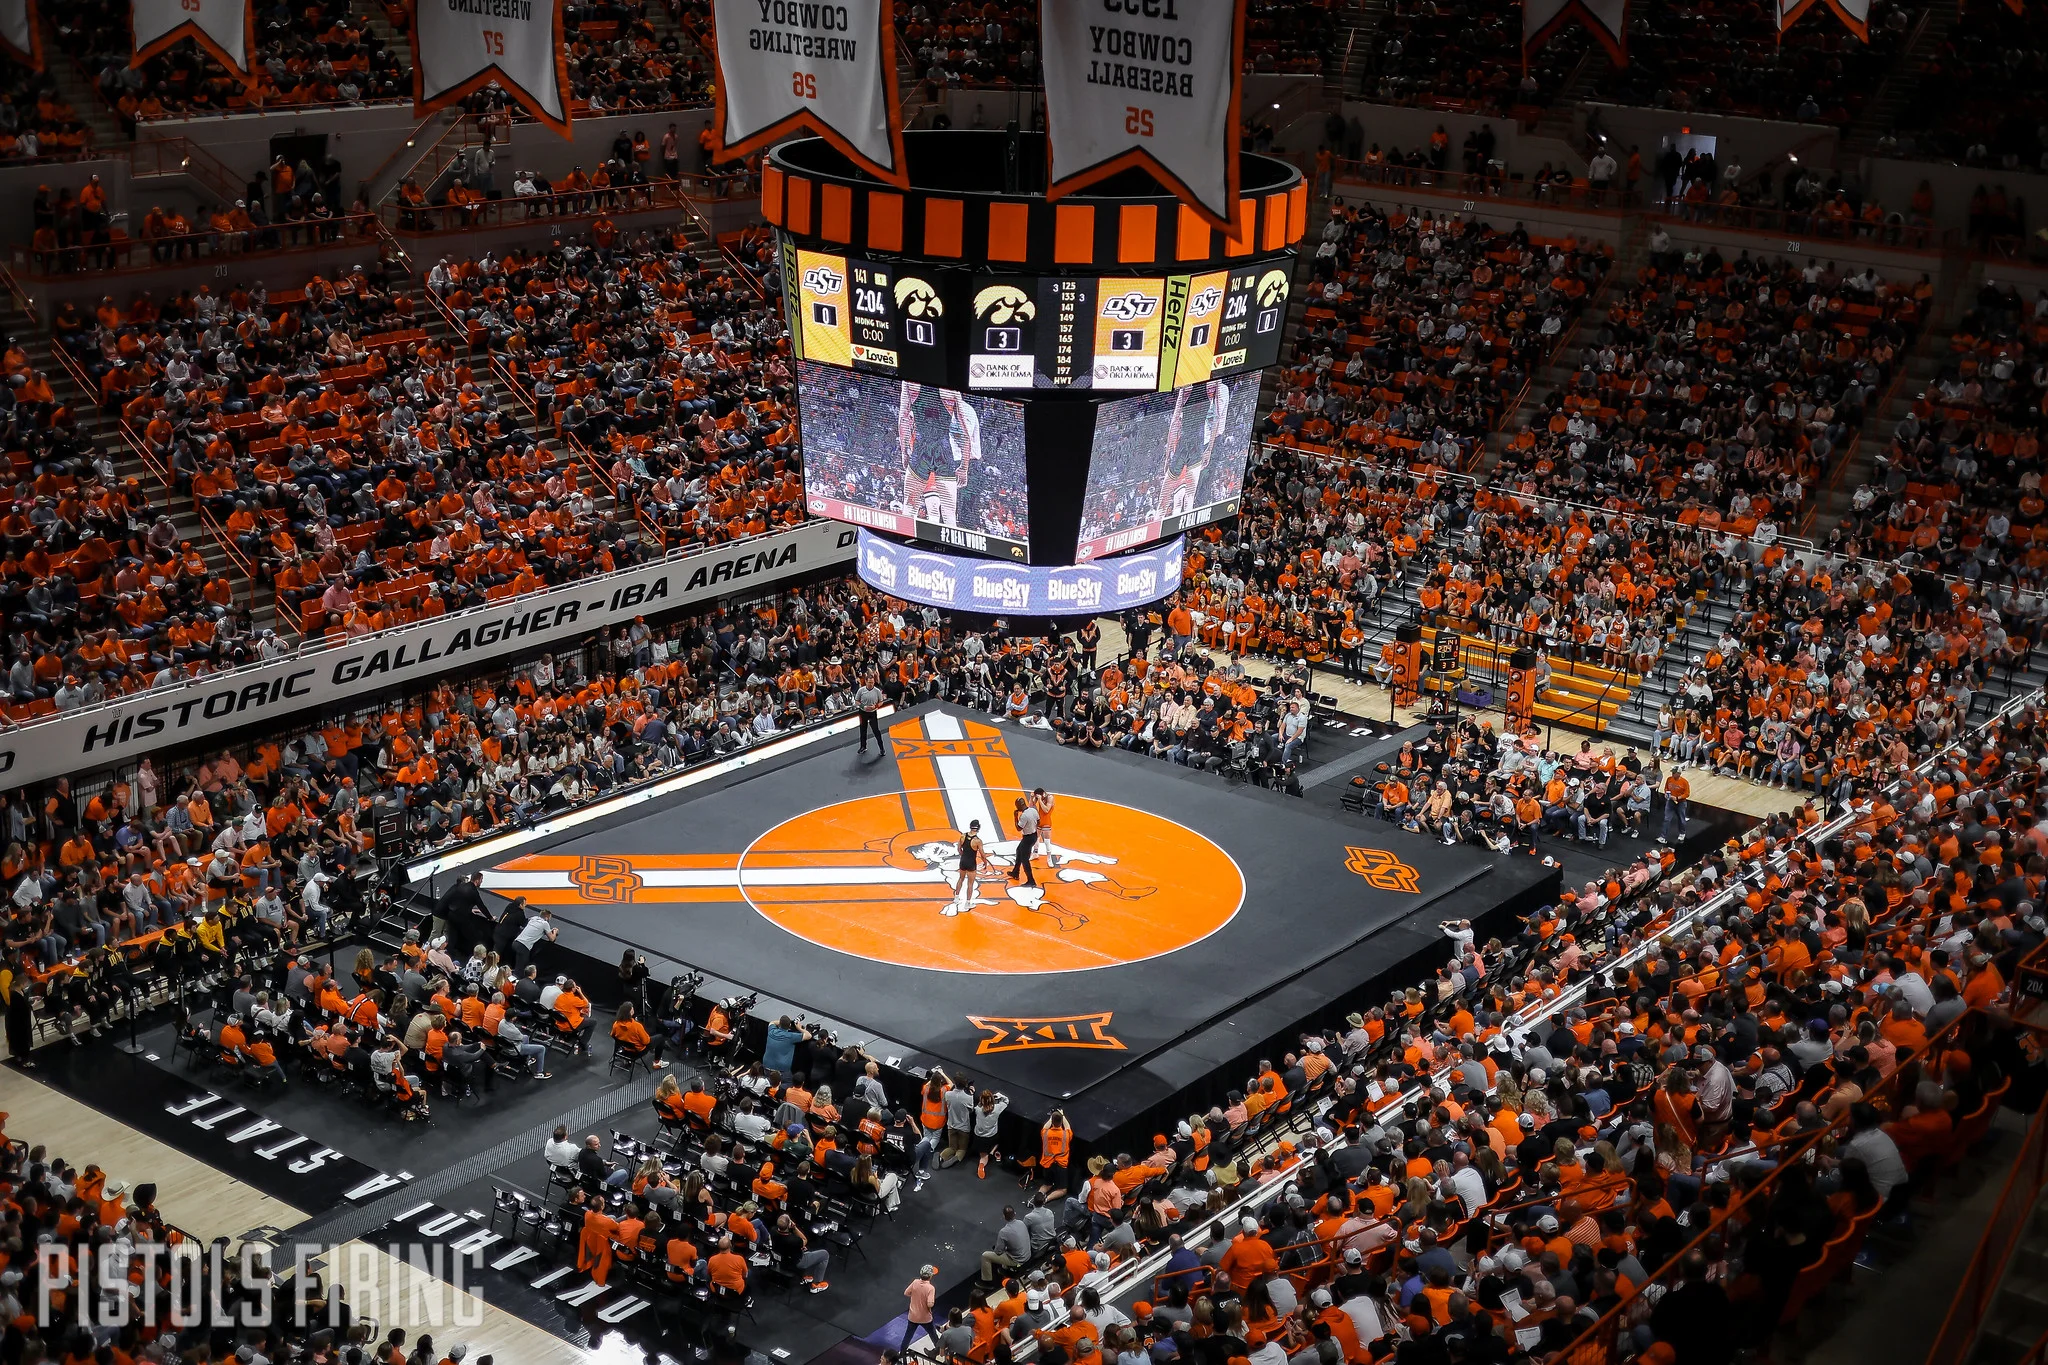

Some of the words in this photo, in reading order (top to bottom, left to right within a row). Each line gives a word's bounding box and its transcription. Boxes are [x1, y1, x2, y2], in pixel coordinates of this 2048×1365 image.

[1787, 241, 1800, 252] 218
[784, 247, 799, 318] Hertz
[802, 267, 844, 296] OSU
[854, 268, 868, 284] 141
[1053, 283, 1059, 292] 3
[1062, 281, 1076, 291] 125
[855, 288, 885, 315] 2:04
[1061, 292, 1076, 301] 133
[1079, 294, 1085, 302] 3
[1188, 286, 1223, 318] OSU
[1061, 303, 1074, 312] 141
[1103, 292, 1160, 321] OSU
[1163, 279, 1187, 350] Hertz
[1226, 294, 1248, 320] 2:04
[822, 308, 830, 326] 0
[854, 316, 875, 328] RIDING
[875, 319, 890, 330] TIME
[1059, 313, 1074, 322] 149
[1265, 313, 1271, 331] 0
[862, 328, 884, 343] 0:00
[917, 325, 924, 342] 0
[1060, 324, 1073, 333] 157
[1197, 328, 1204, 346] 0
[998, 331, 1008, 348] 3
[1058, 335, 1073, 344] 165
[1123, 333, 1132, 350] 3
[1225, 333, 1240, 346] 0:00
[1058, 345, 1072, 354] 174
[1057, 356, 1072, 364] 184
[1057, 366, 1071, 375] 197
[1053, 376, 1073, 385] HWT
[940, 526, 951, 543] #2
[868, 548, 897, 588] BlueSky
[908, 564, 956, 602] BlueSky
[973, 571, 1030, 607] BlueSky
[1118, 568, 1157, 597] BlueSky
[1048, 577, 1103, 607] BlueSky
[1003, 599, 1022, 607] Bank
[1077, 599, 1095, 607] Bank
[82, 668, 316, 754] HISTORIC
[332, 576, 668, 686] GALLAGHER-IBA
[685, 542, 798, 592] ARENA
[2026, 979, 2044, 995] 204
